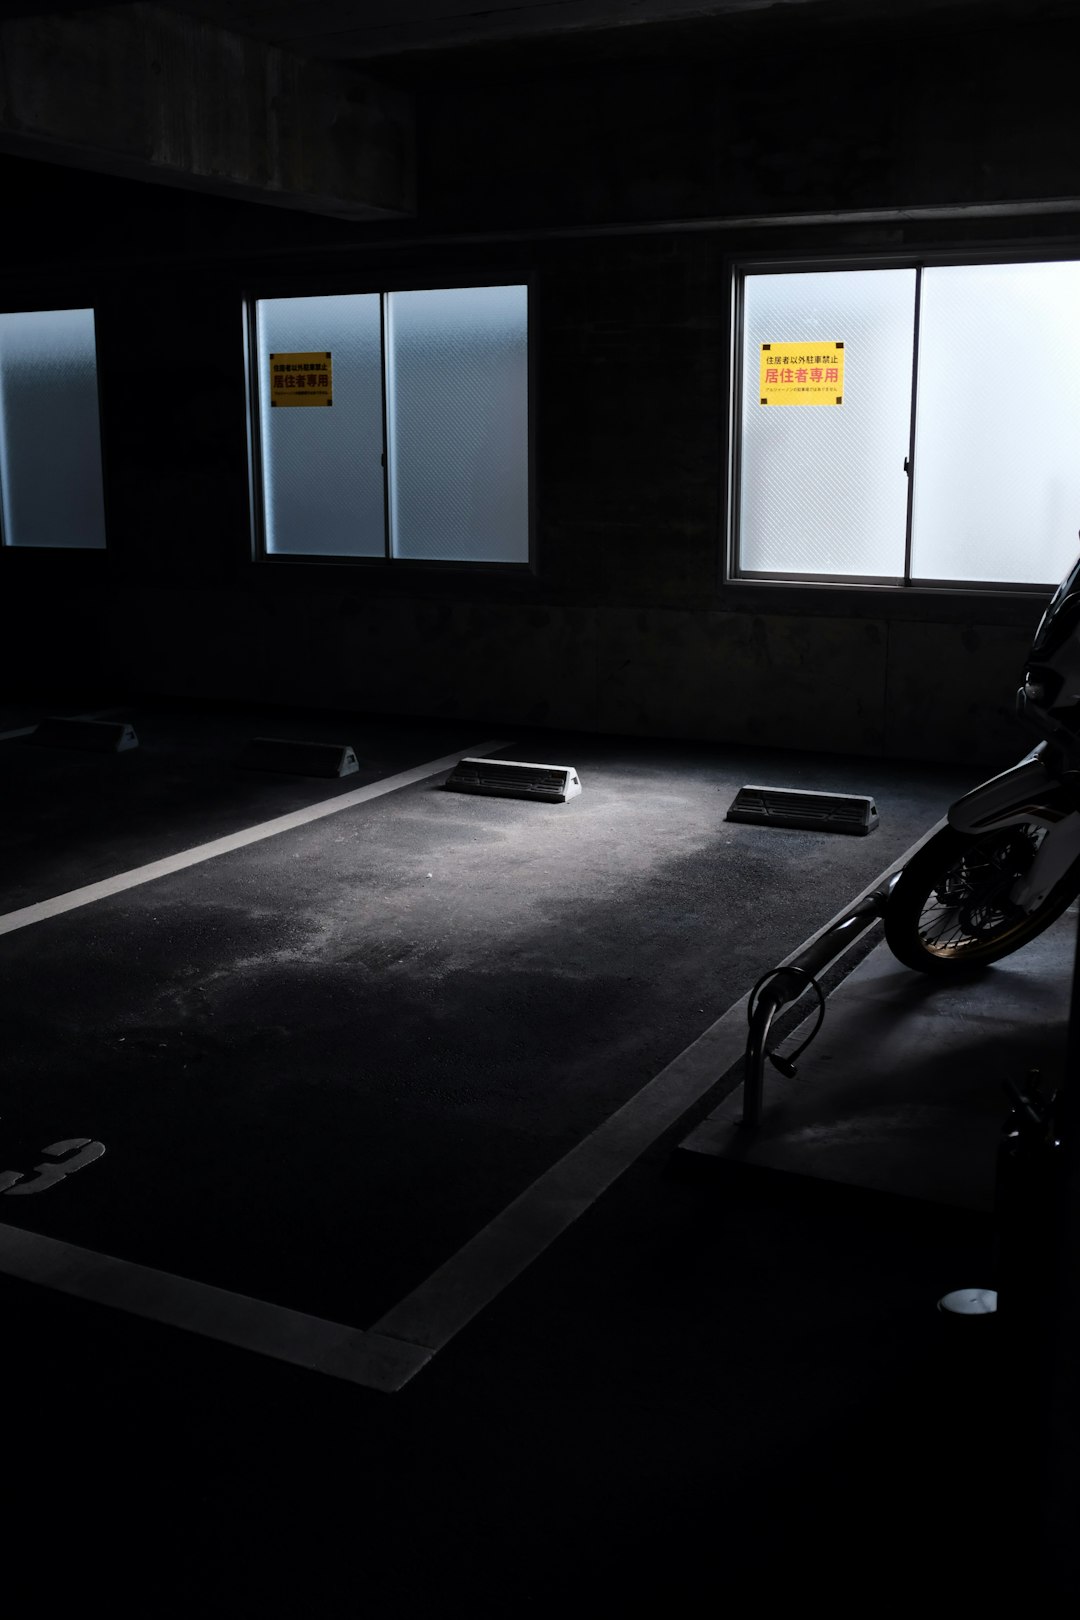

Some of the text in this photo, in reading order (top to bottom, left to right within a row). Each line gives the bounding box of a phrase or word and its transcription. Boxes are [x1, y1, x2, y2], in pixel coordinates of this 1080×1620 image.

[766, 355, 838, 364] 住居者以外駐車禁止
[273, 374, 328, 388] 居住者専用
[765, 368, 839, 383] 居住者専用
